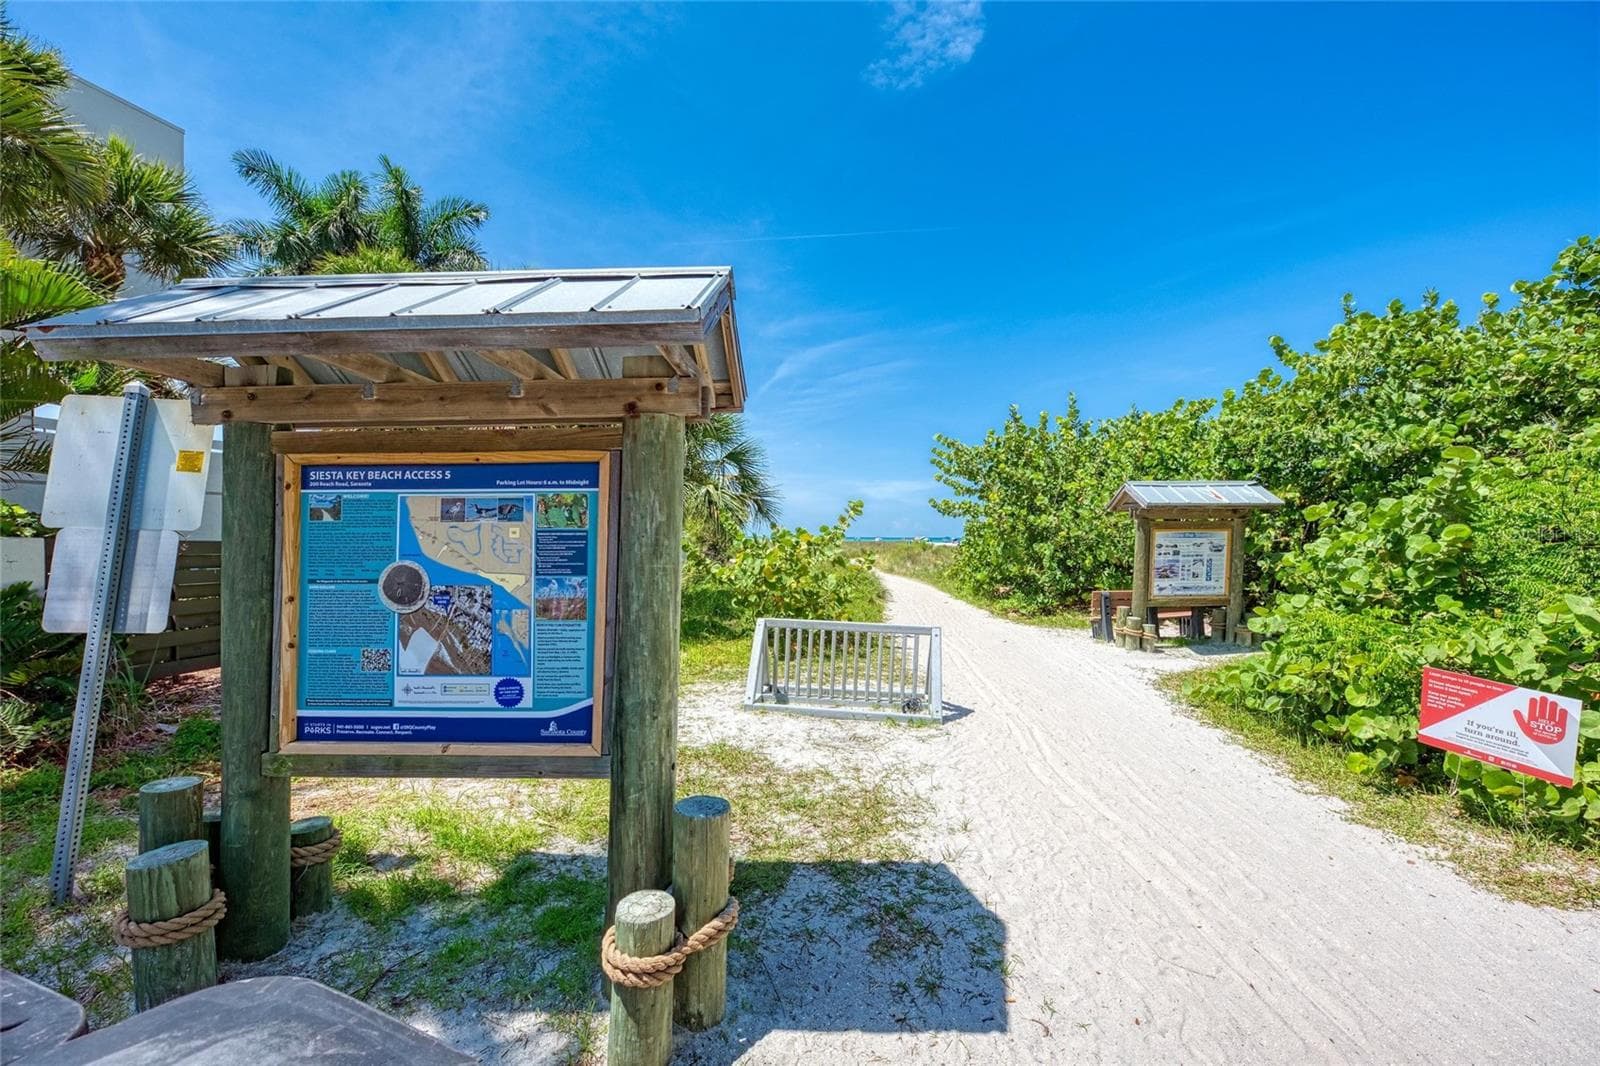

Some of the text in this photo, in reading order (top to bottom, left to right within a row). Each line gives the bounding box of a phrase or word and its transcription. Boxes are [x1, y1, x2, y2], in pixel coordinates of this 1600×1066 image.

[310, 471, 344, 480] SIESTA
[346, 471, 366, 480] KEY
[368, 470, 402, 480] BEACH
[404, 470, 442, 480] ACCESS
[1476, 723, 1504, 735] you're
[1530, 720, 1562, 734] STOP
[1464, 727, 1483, 737] turn
[1486, 733, 1520, 747] around.
